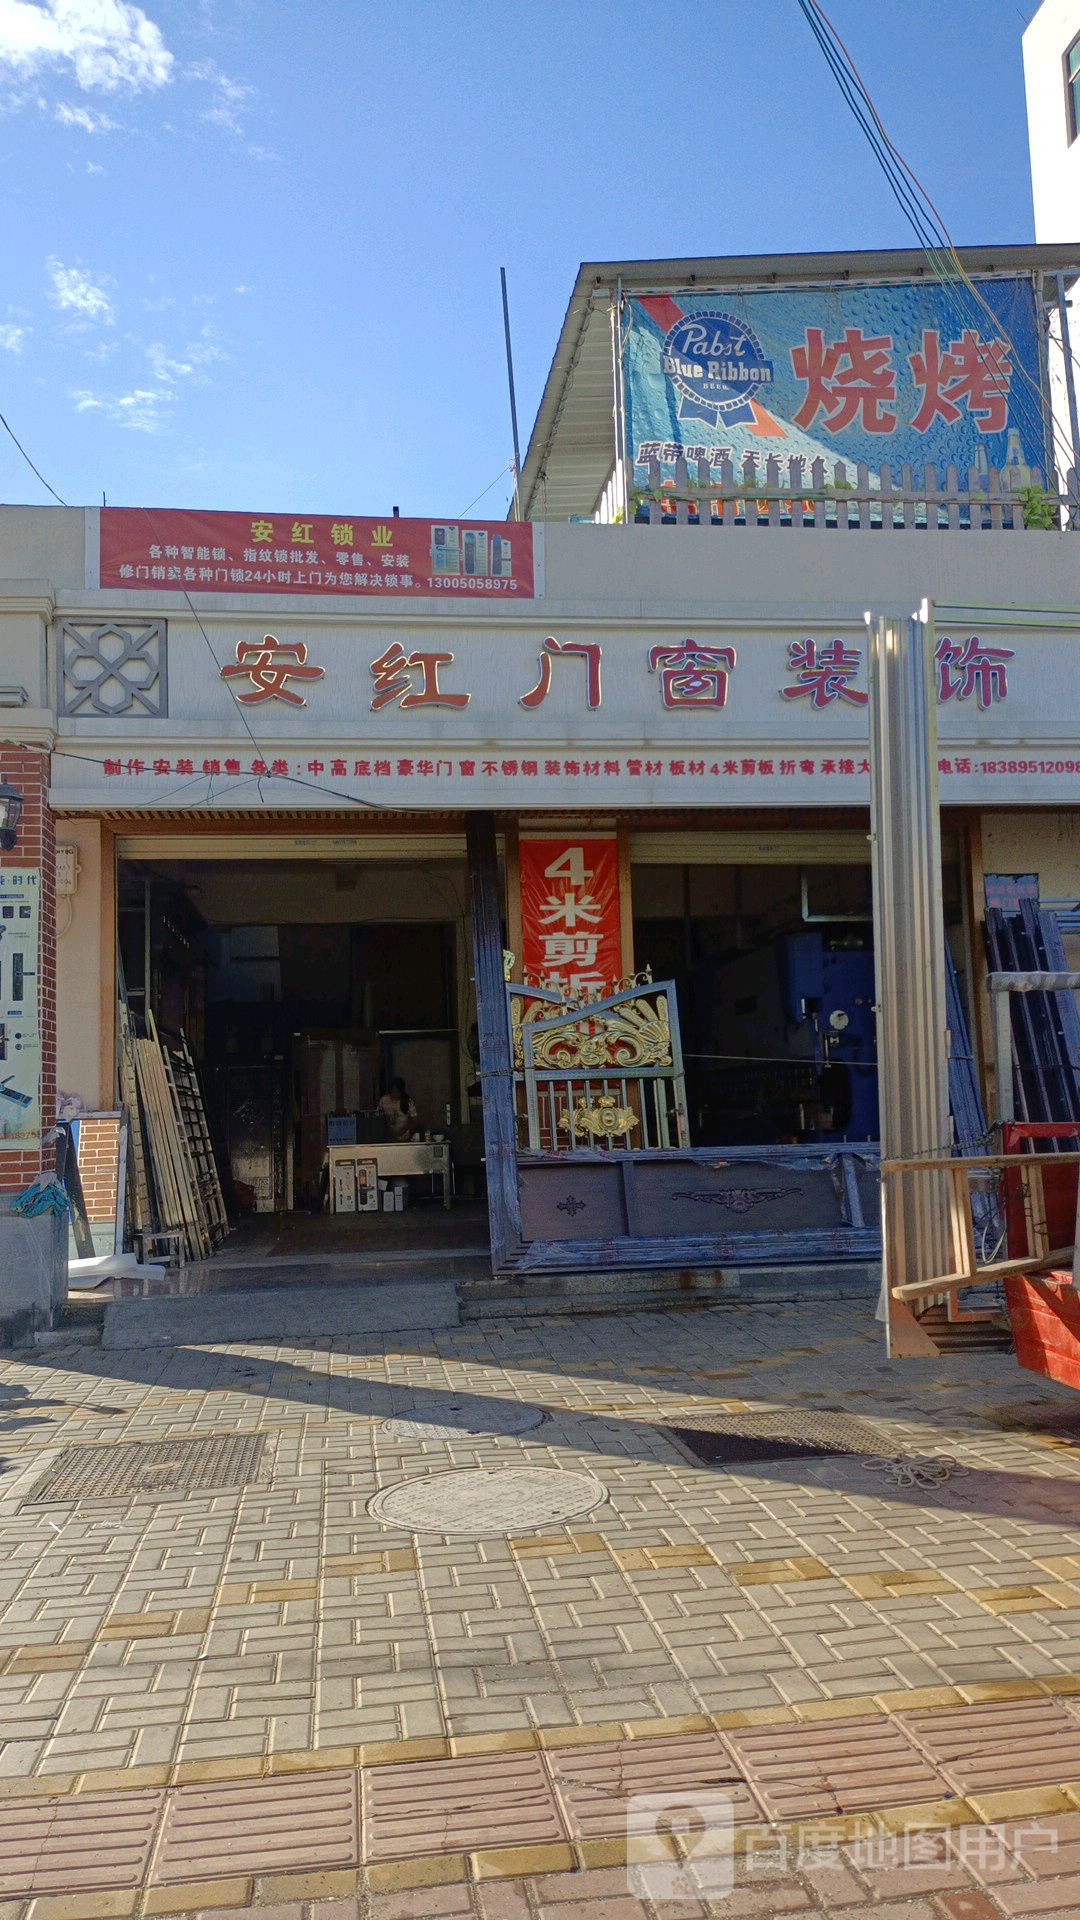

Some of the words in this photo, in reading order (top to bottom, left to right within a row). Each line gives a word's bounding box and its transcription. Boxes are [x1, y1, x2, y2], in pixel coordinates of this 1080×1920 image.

[680, 323, 747, 357] Pabst
[663, 355, 704, 379] Blue
[707, 360, 773, 382] Ribbon
[789, 327, 1013, 435] 烧烤
[250, 519, 394, 548] 安红锁业
[426, 576, 519, 591] 13005058975
[219, 633, 1017, 712] 安红门窗装饰
